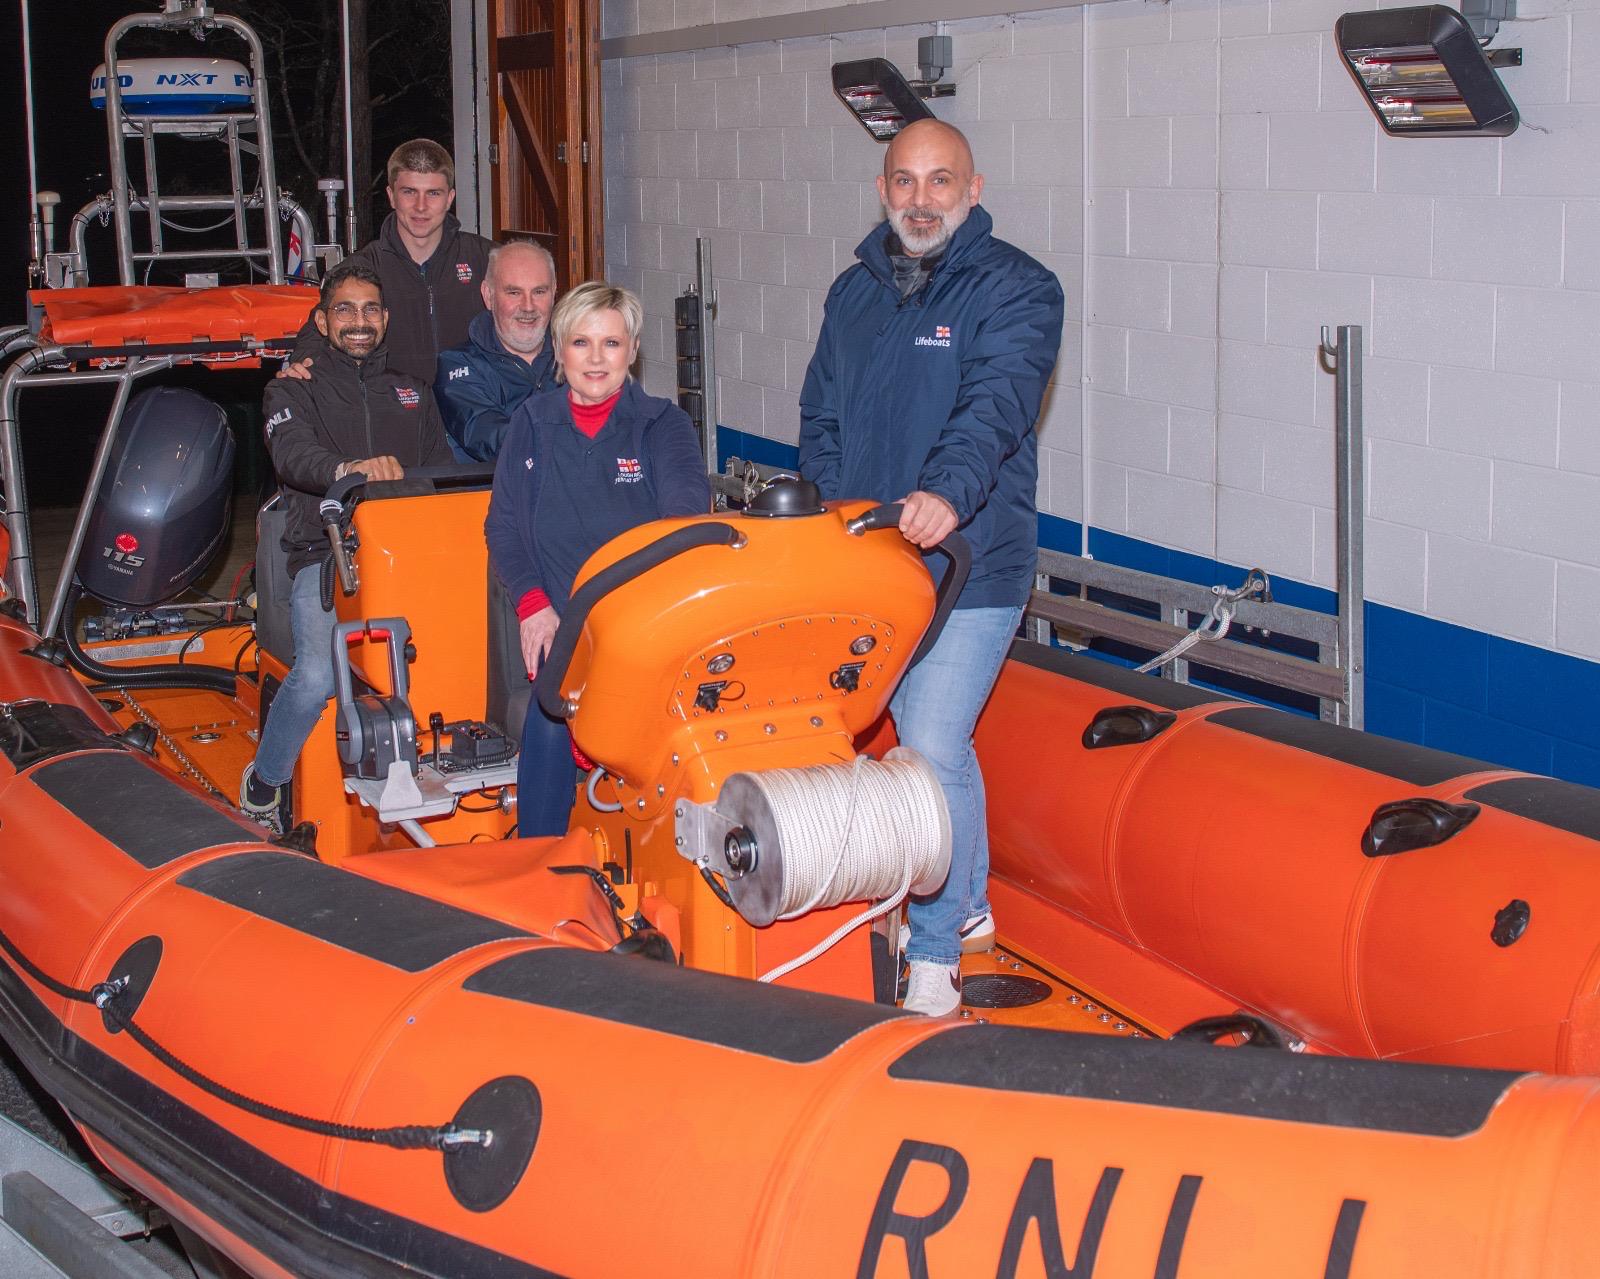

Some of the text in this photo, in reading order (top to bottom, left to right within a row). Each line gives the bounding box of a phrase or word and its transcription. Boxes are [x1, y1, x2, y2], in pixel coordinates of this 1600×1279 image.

[156, 73, 219, 87] NXT
[915, 336, 950, 347] Lifeboats
[449, 366, 470, 380] HH
[103, 547, 145, 567] 115
